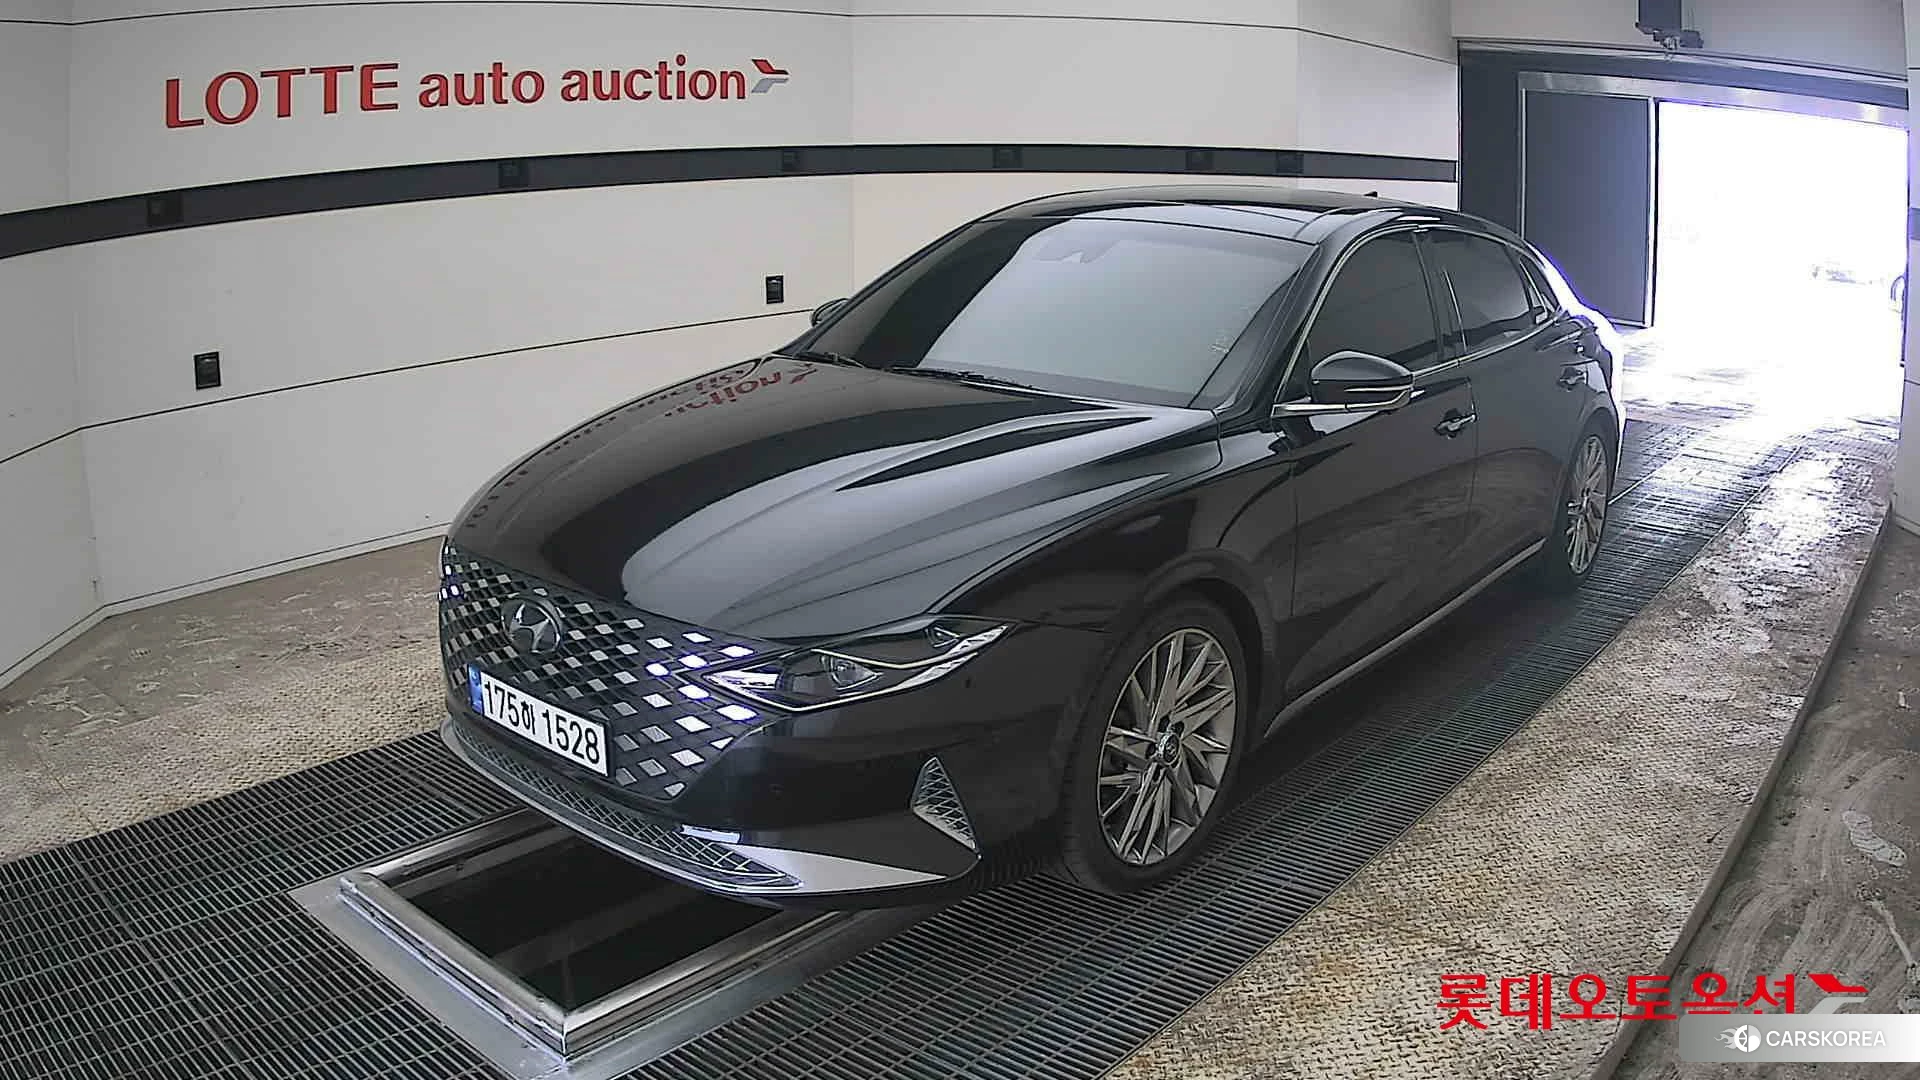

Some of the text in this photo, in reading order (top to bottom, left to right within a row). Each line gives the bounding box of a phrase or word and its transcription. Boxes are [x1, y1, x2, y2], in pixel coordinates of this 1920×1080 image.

[166, 54, 747, 129] LOTTE auto auction
[484, 681, 600, 764] 175하 1528
